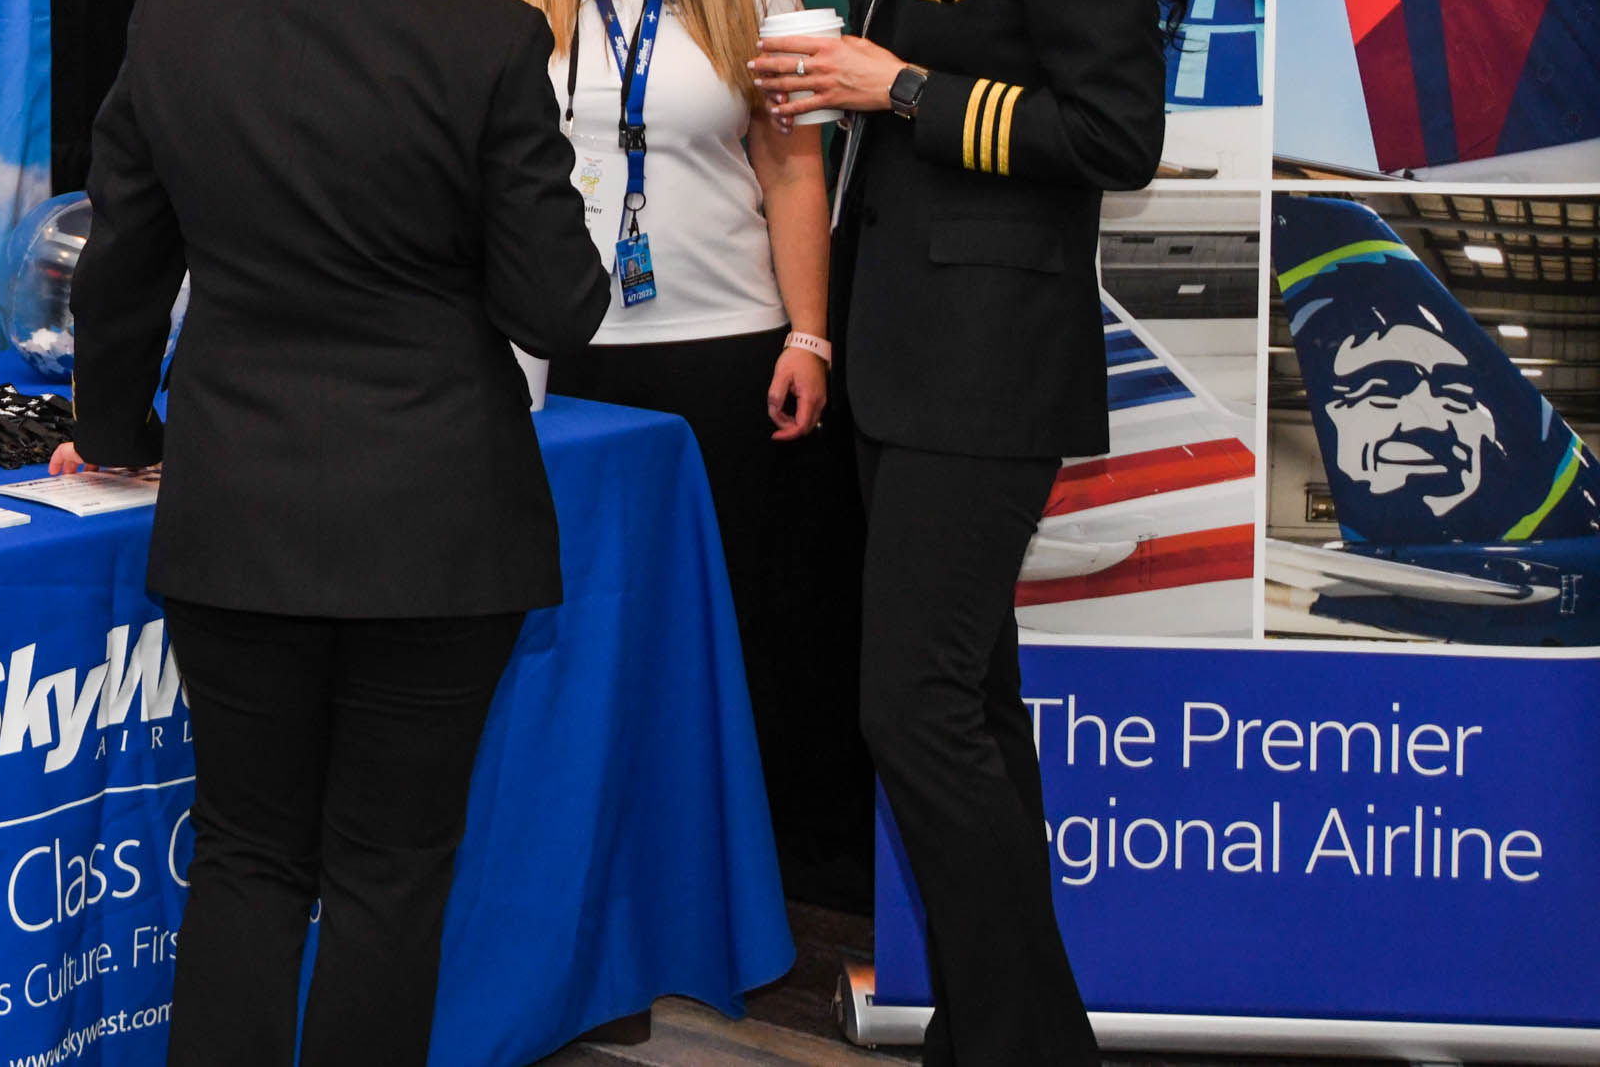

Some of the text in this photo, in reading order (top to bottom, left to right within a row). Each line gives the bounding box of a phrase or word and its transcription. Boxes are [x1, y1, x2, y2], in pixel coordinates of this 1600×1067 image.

[95, 721, 193, 760] AIRL
[1022, 695, 1483, 777] The Premier
[1046, 797, 1543, 886] gional Airline
[8, 838, 141, 933] Class
[24, 942, 119, 1008] Culture.
